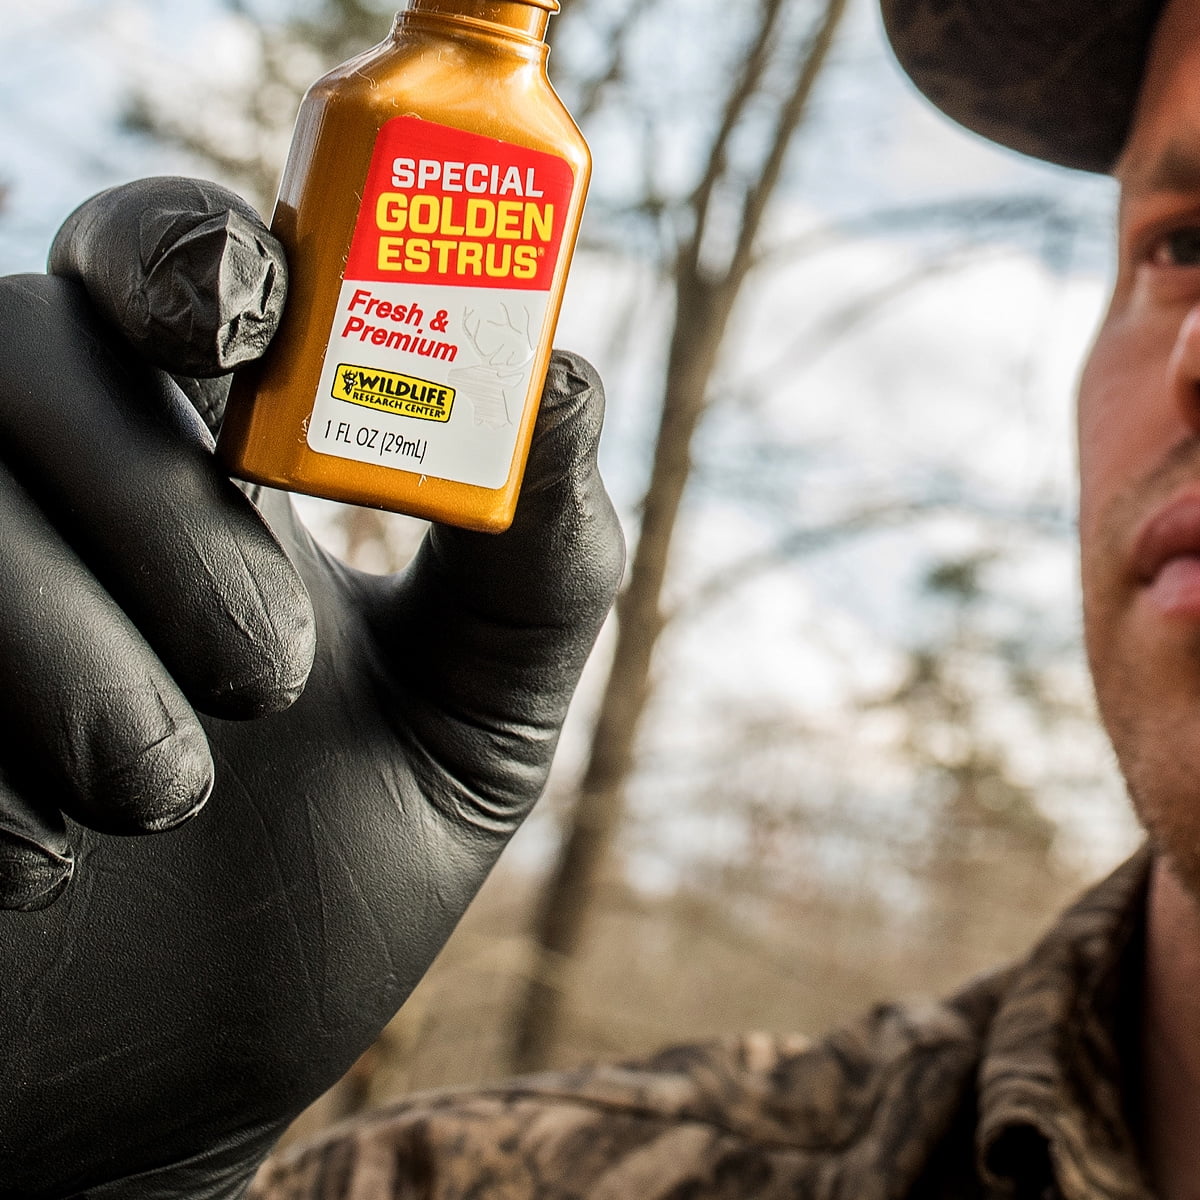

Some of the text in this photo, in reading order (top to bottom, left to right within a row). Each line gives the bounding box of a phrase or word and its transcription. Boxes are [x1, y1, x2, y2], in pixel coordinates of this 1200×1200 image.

[391, 157, 544, 198] SPECIAL
[375, 192, 555, 242] GOLDEN
[347, 289, 449, 333] Fresh &
[341, 316, 458, 362] Premium
[352, 391, 403, 410] RESEARCH
[358, 371, 448, 407] WILDLIFE
[324, 420, 427, 464] 1 FL OZ (29mL)
